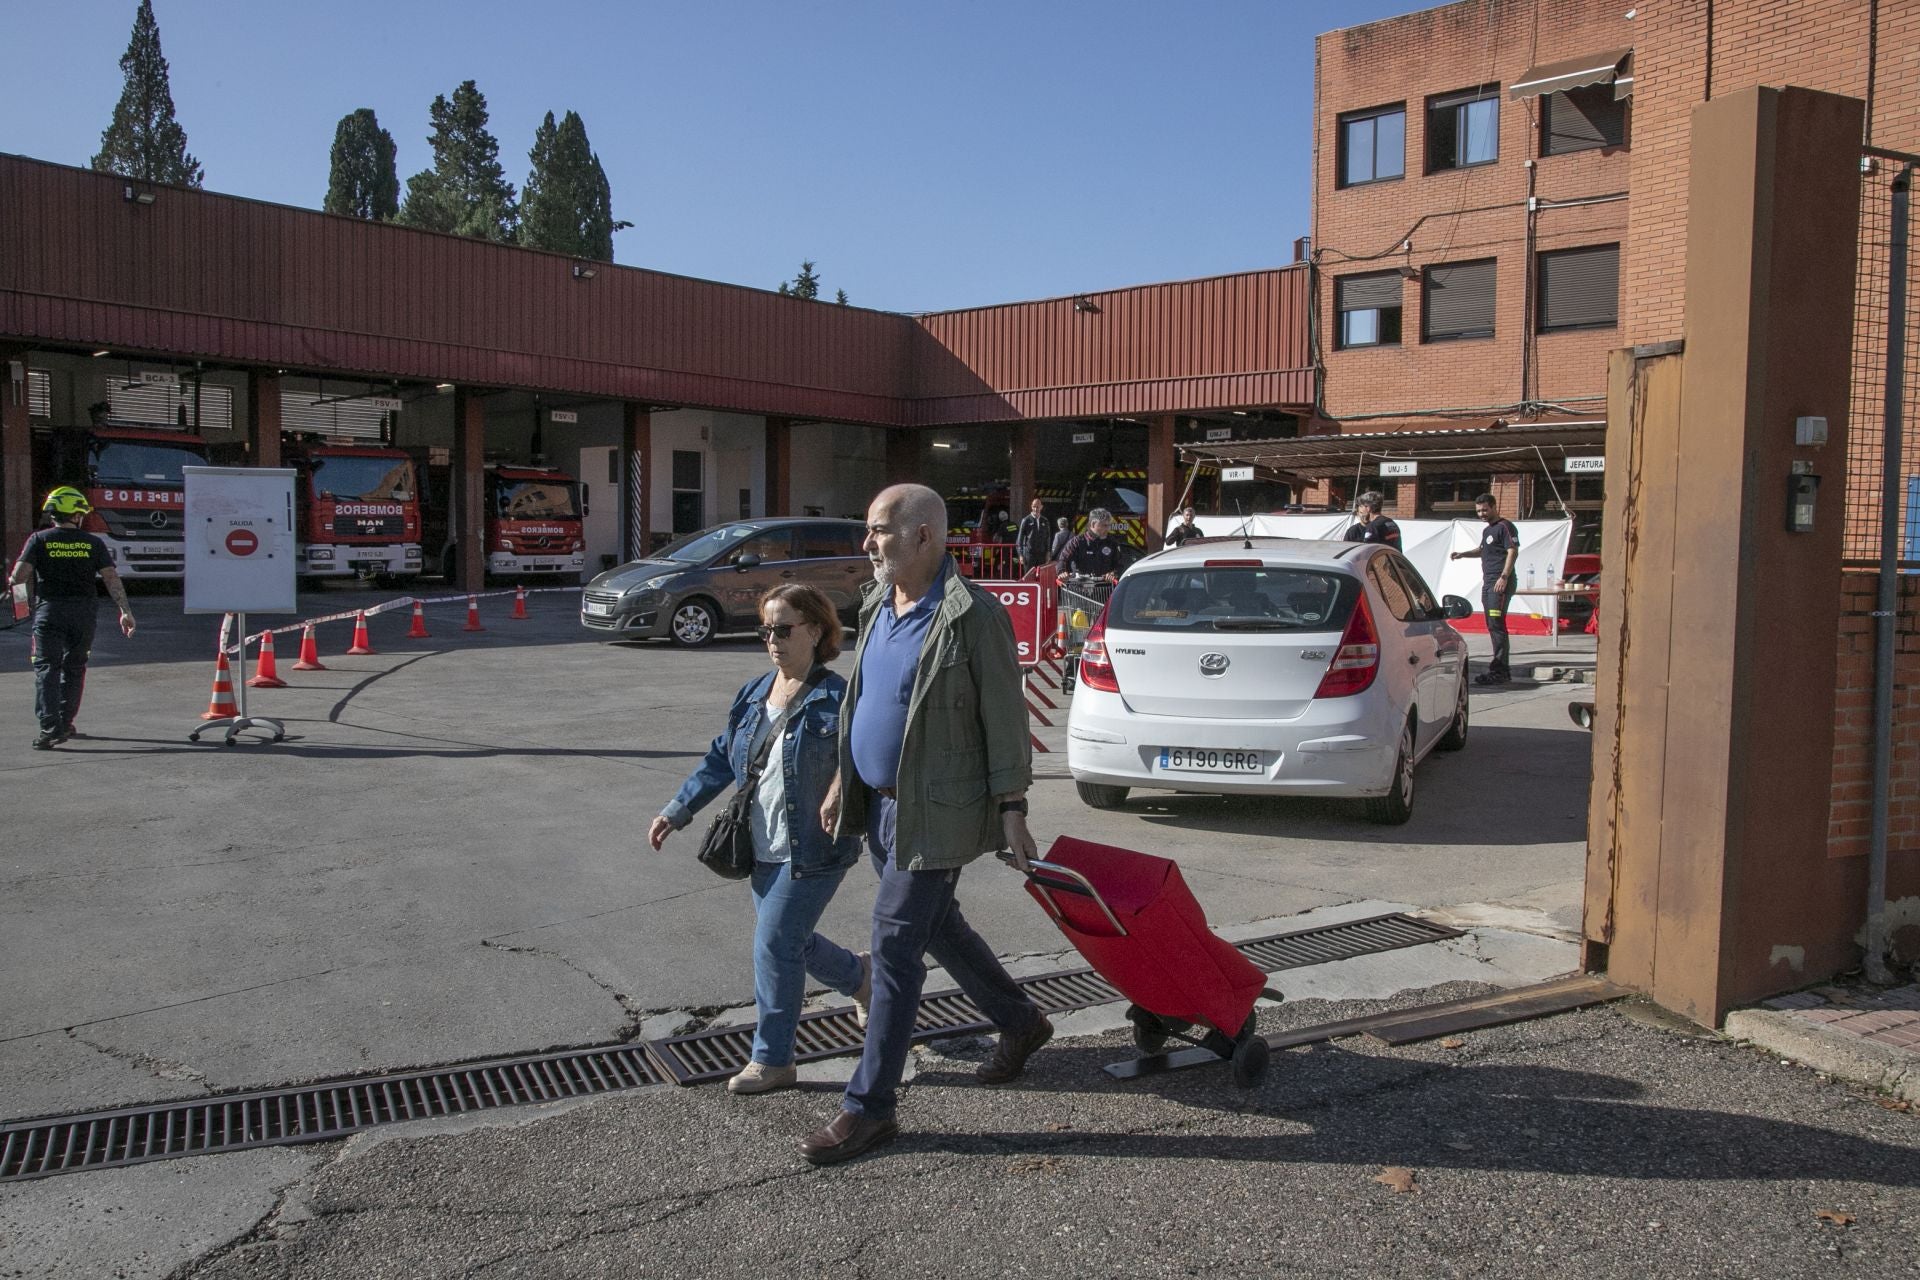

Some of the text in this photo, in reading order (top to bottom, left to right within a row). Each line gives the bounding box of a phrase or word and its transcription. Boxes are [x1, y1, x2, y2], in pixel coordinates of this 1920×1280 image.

[145, 374, 176, 383] BCA-3
[1570, 460, 1604, 469] JEFATURA
[229, 519, 253, 527] SALIDA
[46, 542, 92, 550] BOMBEROS
[49, 549, 90, 558] CÓRDOBA
[1115, 648, 1146, 656] HYUNDAI
[1172, 750, 1218, 768] 6190
[1222, 752, 1258, 770] GRC
